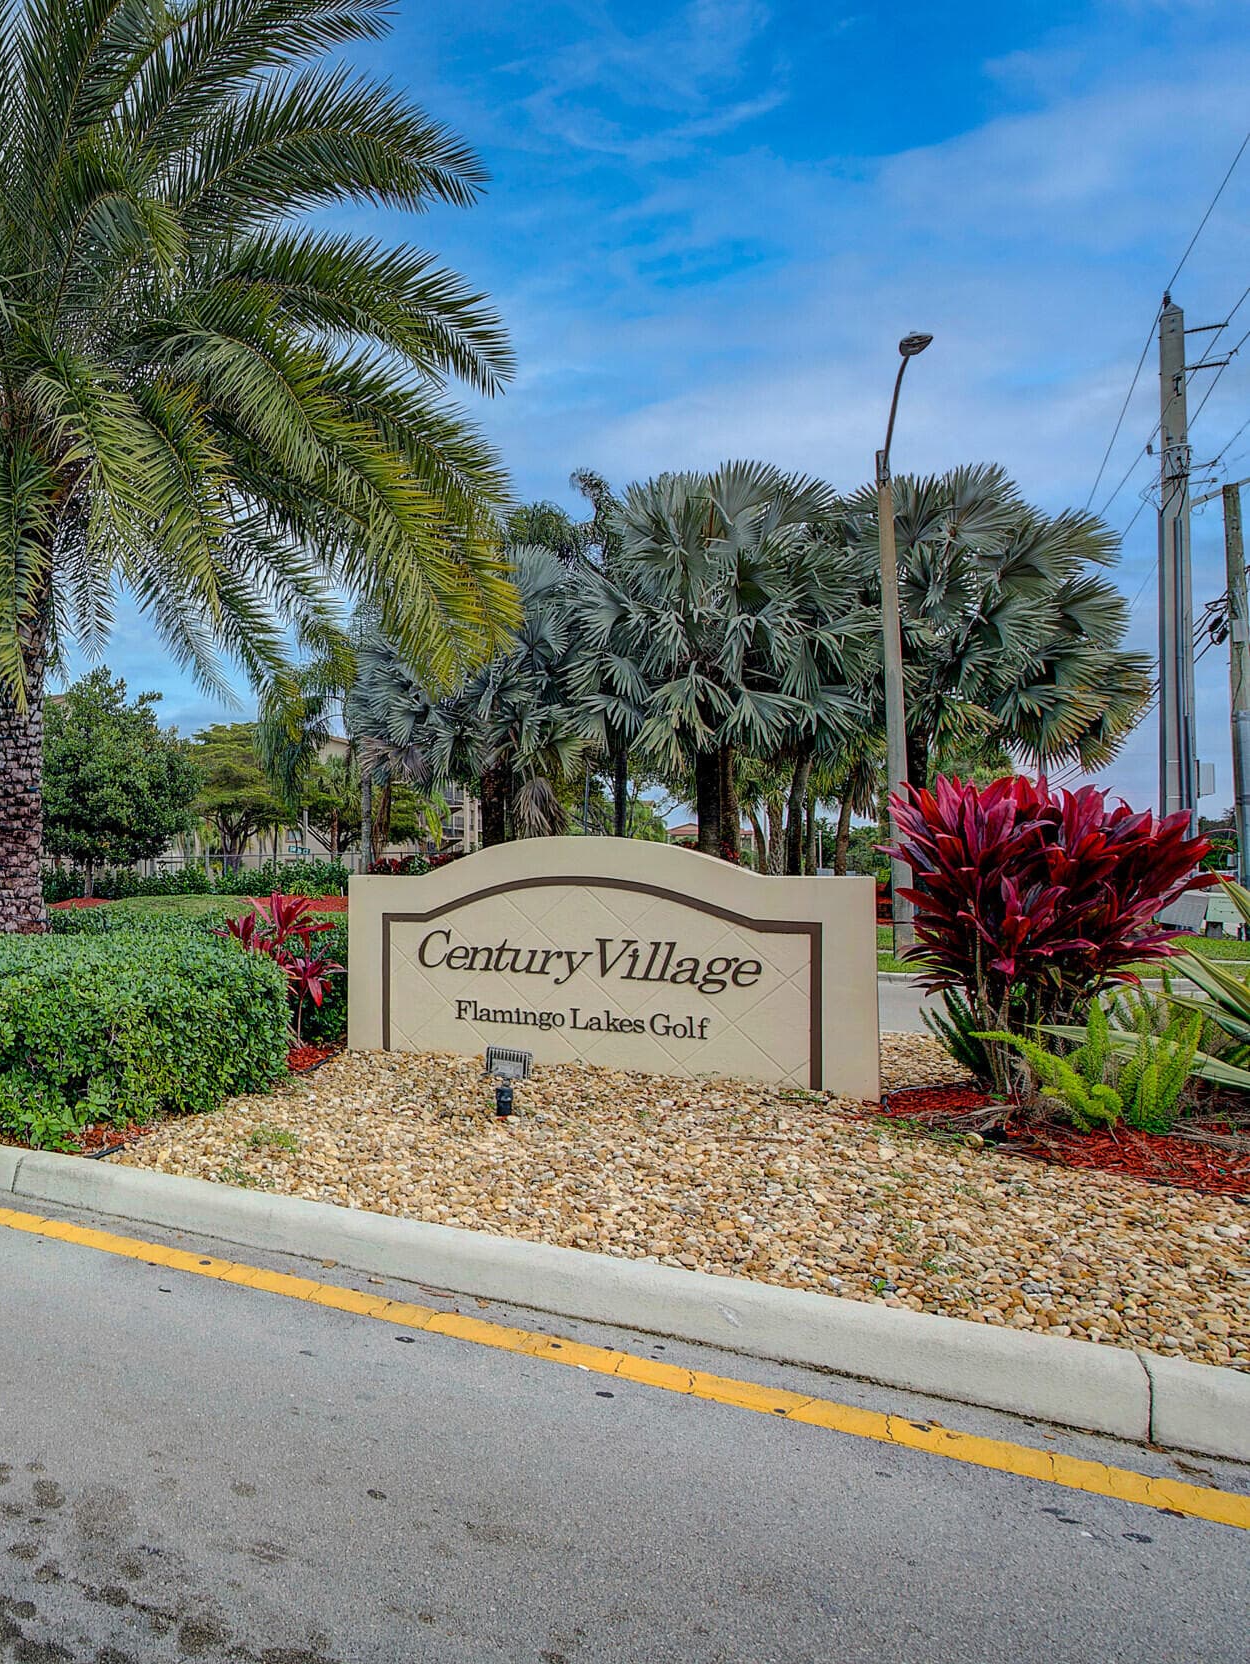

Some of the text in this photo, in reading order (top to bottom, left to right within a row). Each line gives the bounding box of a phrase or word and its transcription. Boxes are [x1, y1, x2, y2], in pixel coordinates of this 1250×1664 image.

[418, 929, 763, 994] Century Village
[454, 1000, 710, 1040] Flamingo Lakes Golf
